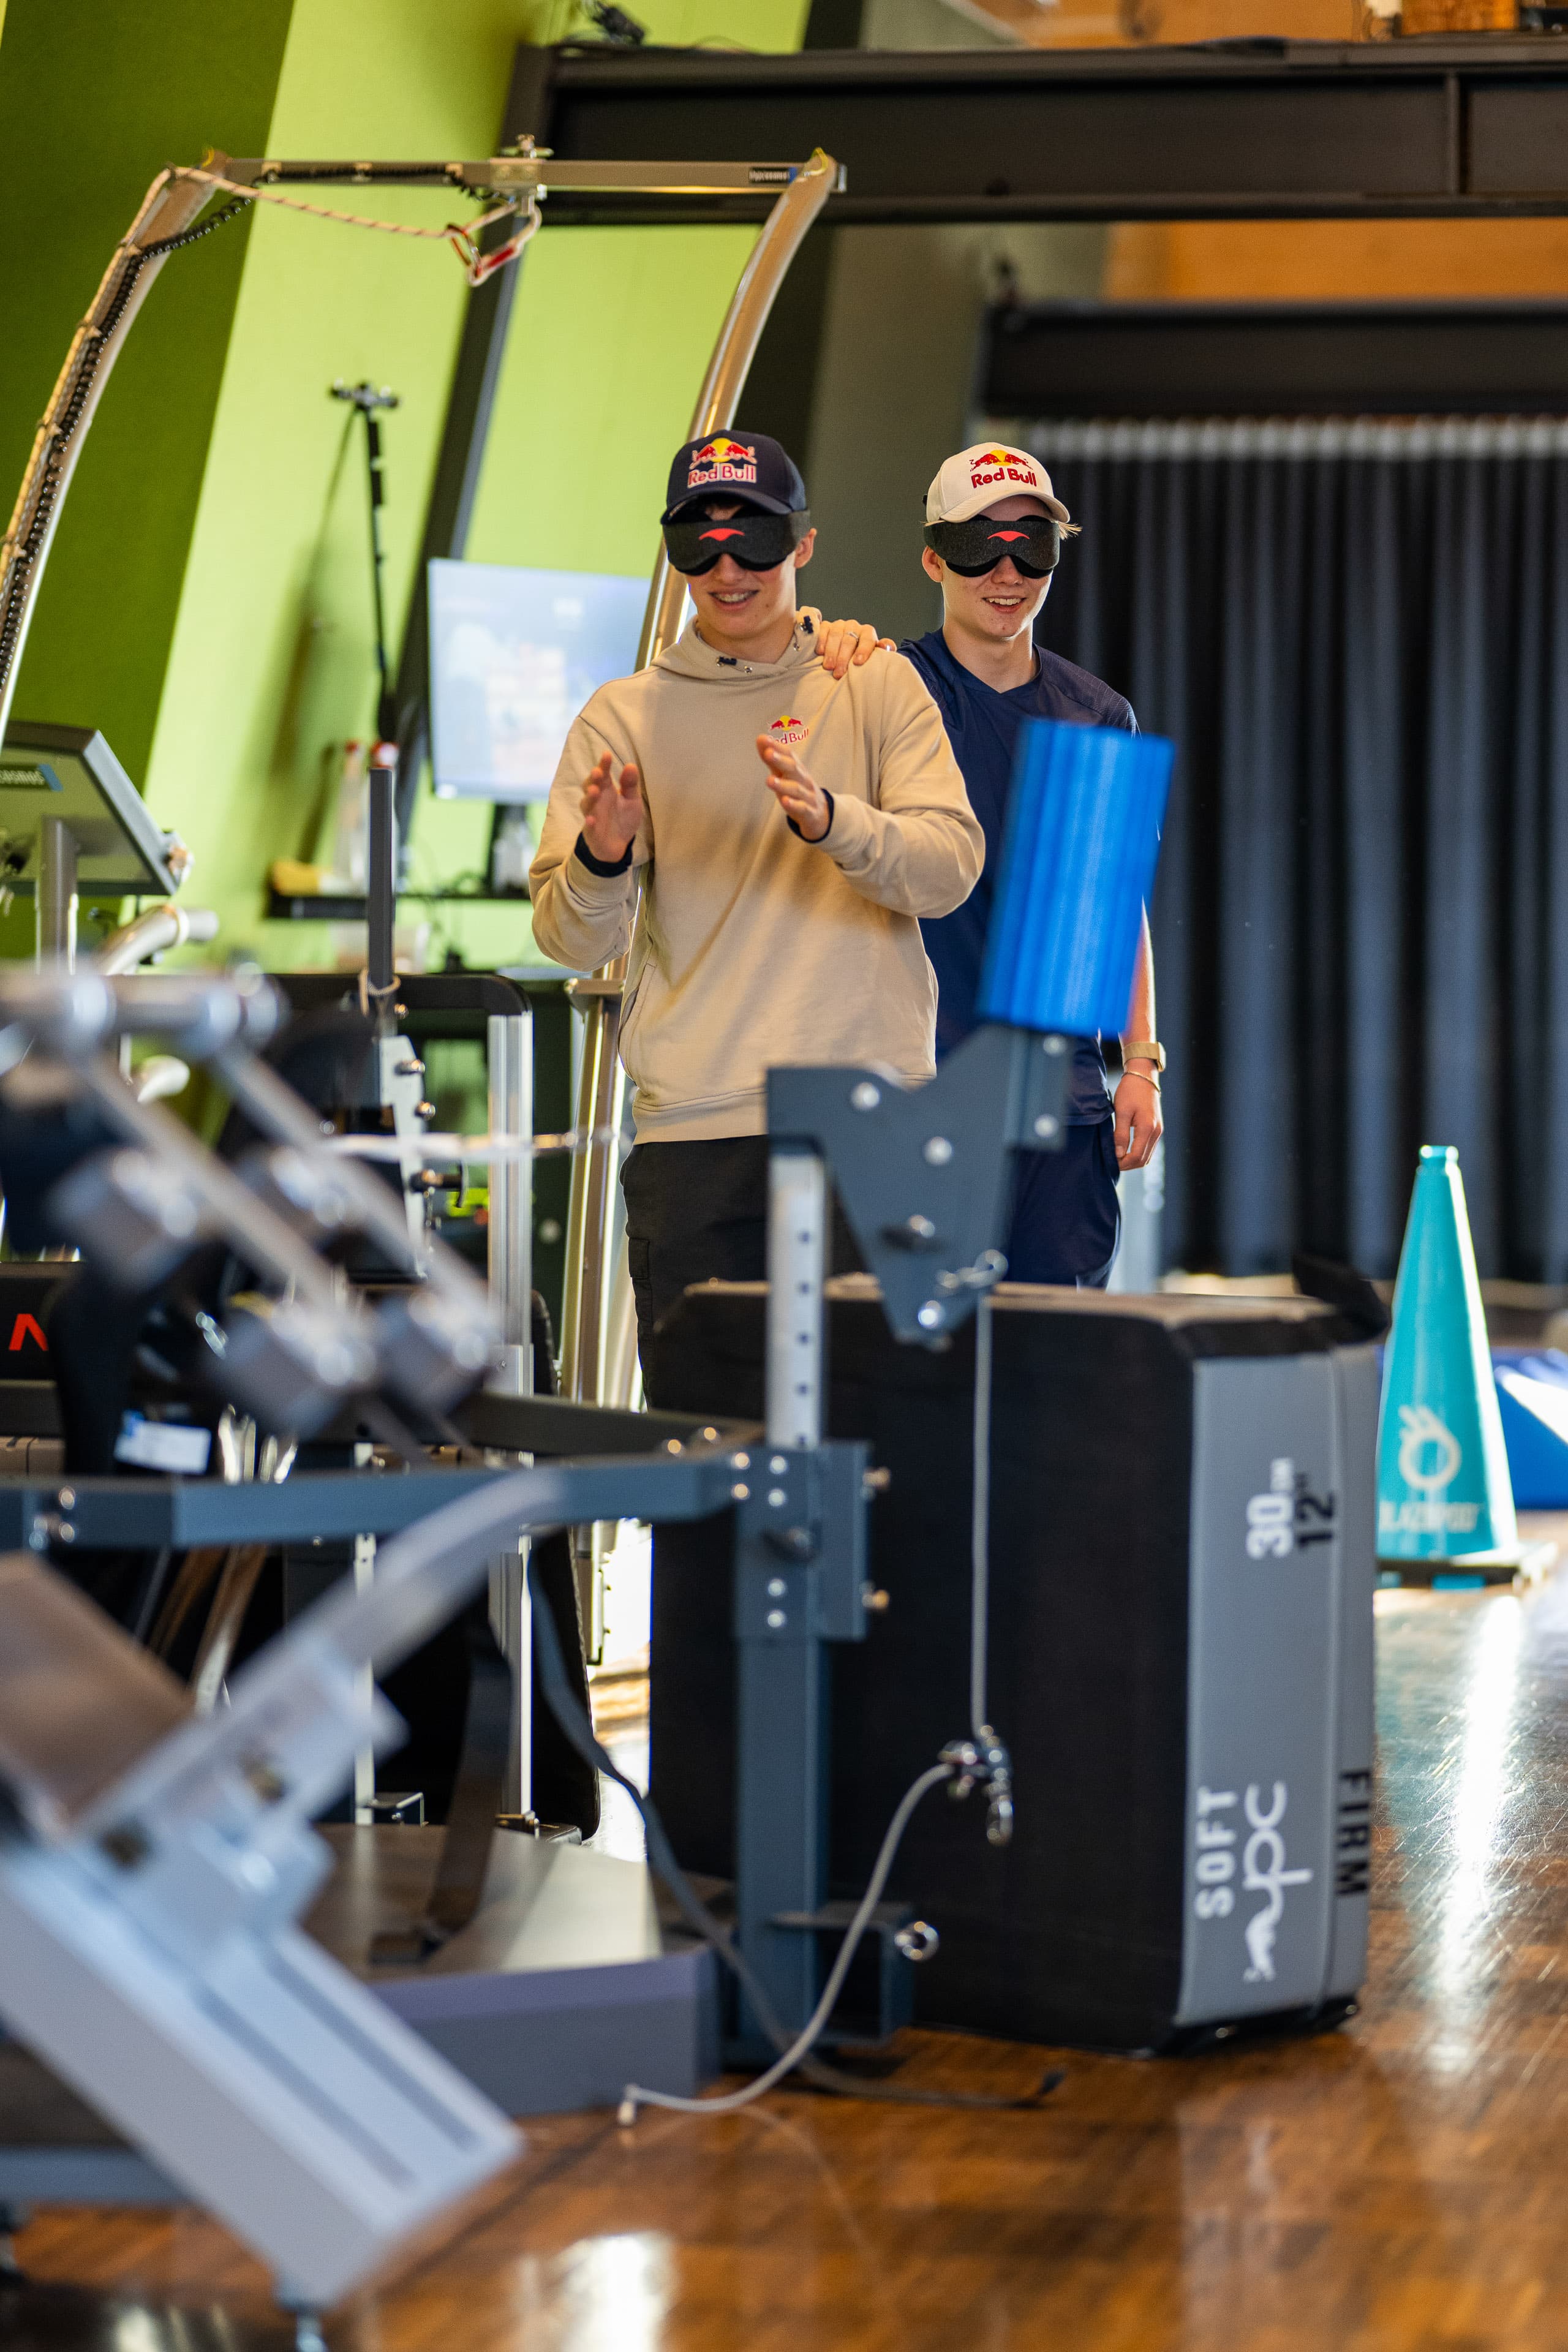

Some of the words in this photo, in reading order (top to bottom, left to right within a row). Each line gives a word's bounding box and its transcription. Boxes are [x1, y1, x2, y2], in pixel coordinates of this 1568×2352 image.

[687, 462, 720, 488] Red
[720, 463, 756, 483] Bull
[971, 467, 1005, 488] Red
[1006, 468, 1037, 487] Bull
[788, 728, 809, 743] Bull
[1246, 1493, 1294, 1558] 30
[1294, 1492, 1334, 1548] 12
[1195, 1786, 1238, 1919] SOFT
[1335, 1770, 1371, 1895] FIRM
